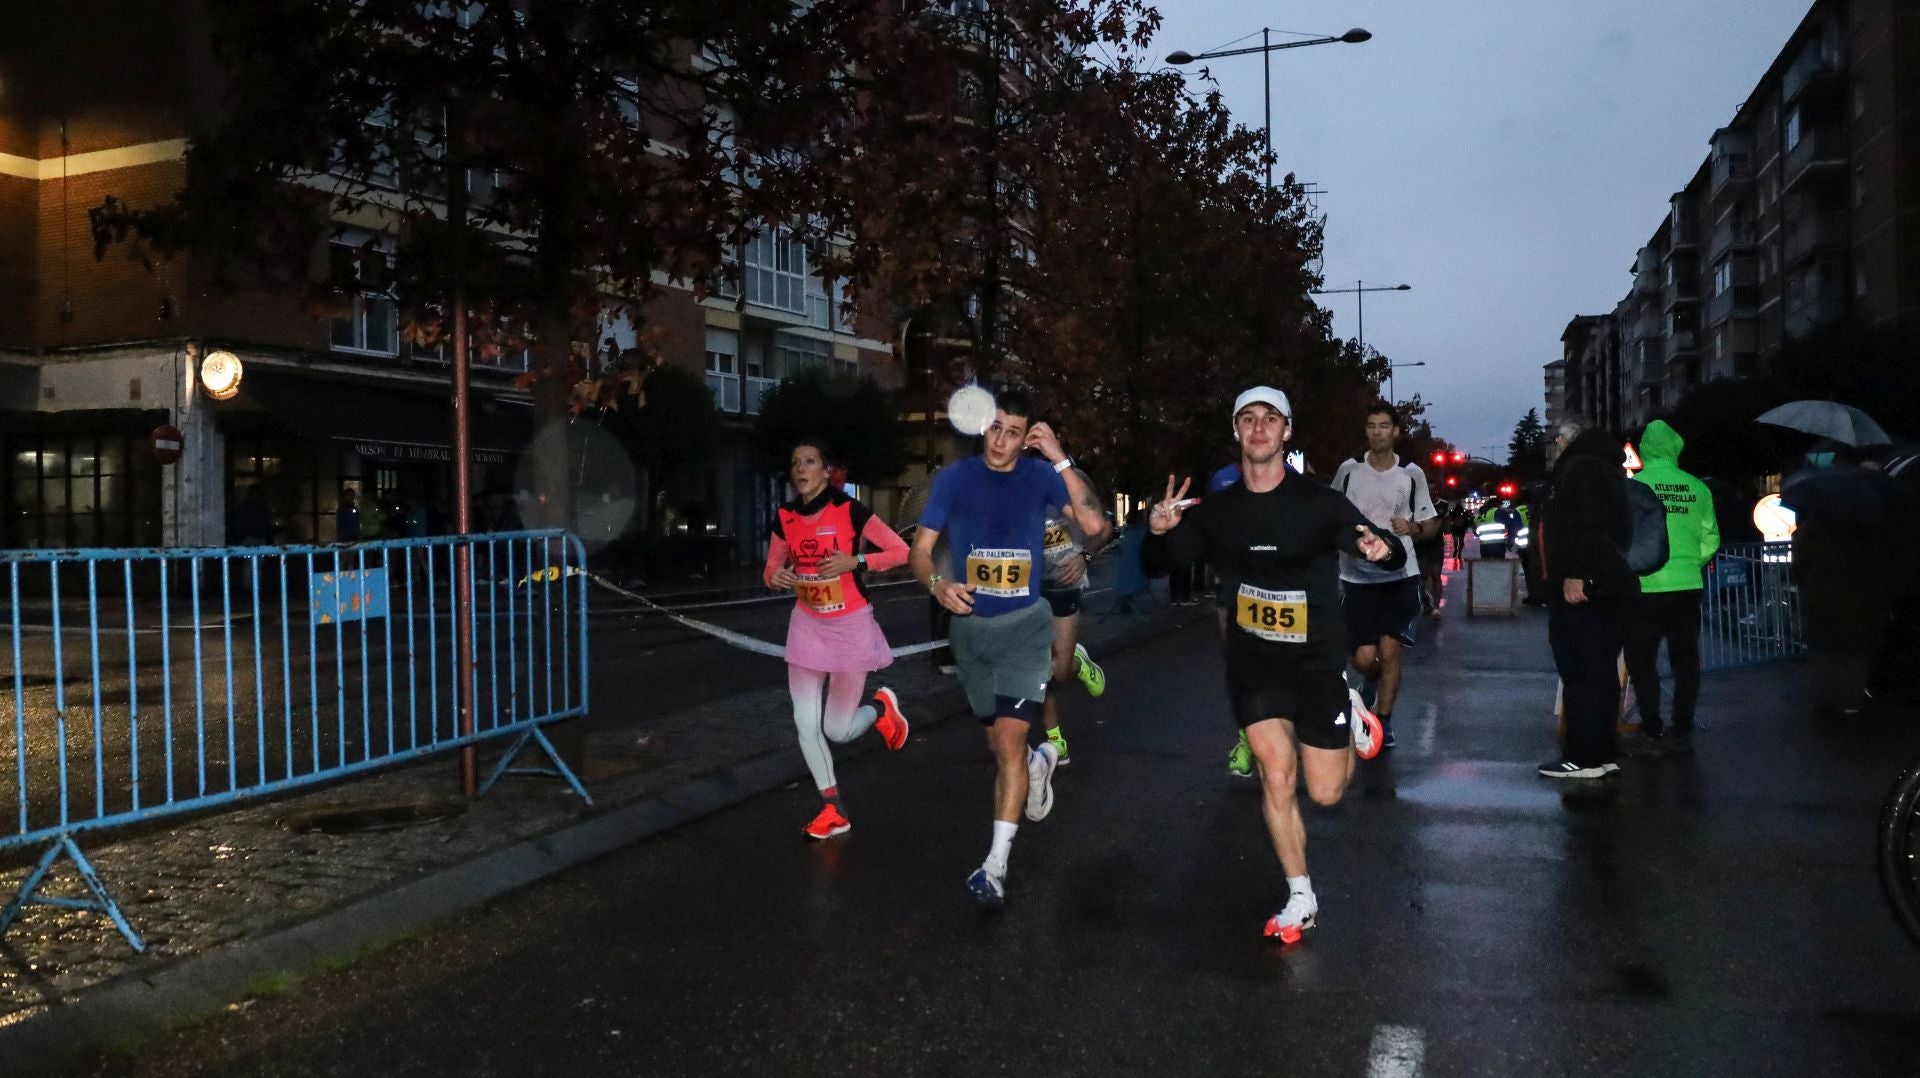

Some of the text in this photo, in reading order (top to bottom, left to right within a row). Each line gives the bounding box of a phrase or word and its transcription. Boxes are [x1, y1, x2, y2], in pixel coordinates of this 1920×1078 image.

[1655, 484, 1689, 492] ATLETISMO
[987, 550, 1015, 558] PALENCIA
[976, 564, 1020, 583] 615
[799, 584, 833, 602] 721
[1256, 591, 1287, 601] PALENCIA
[1247, 603, 1295, 628] 185
